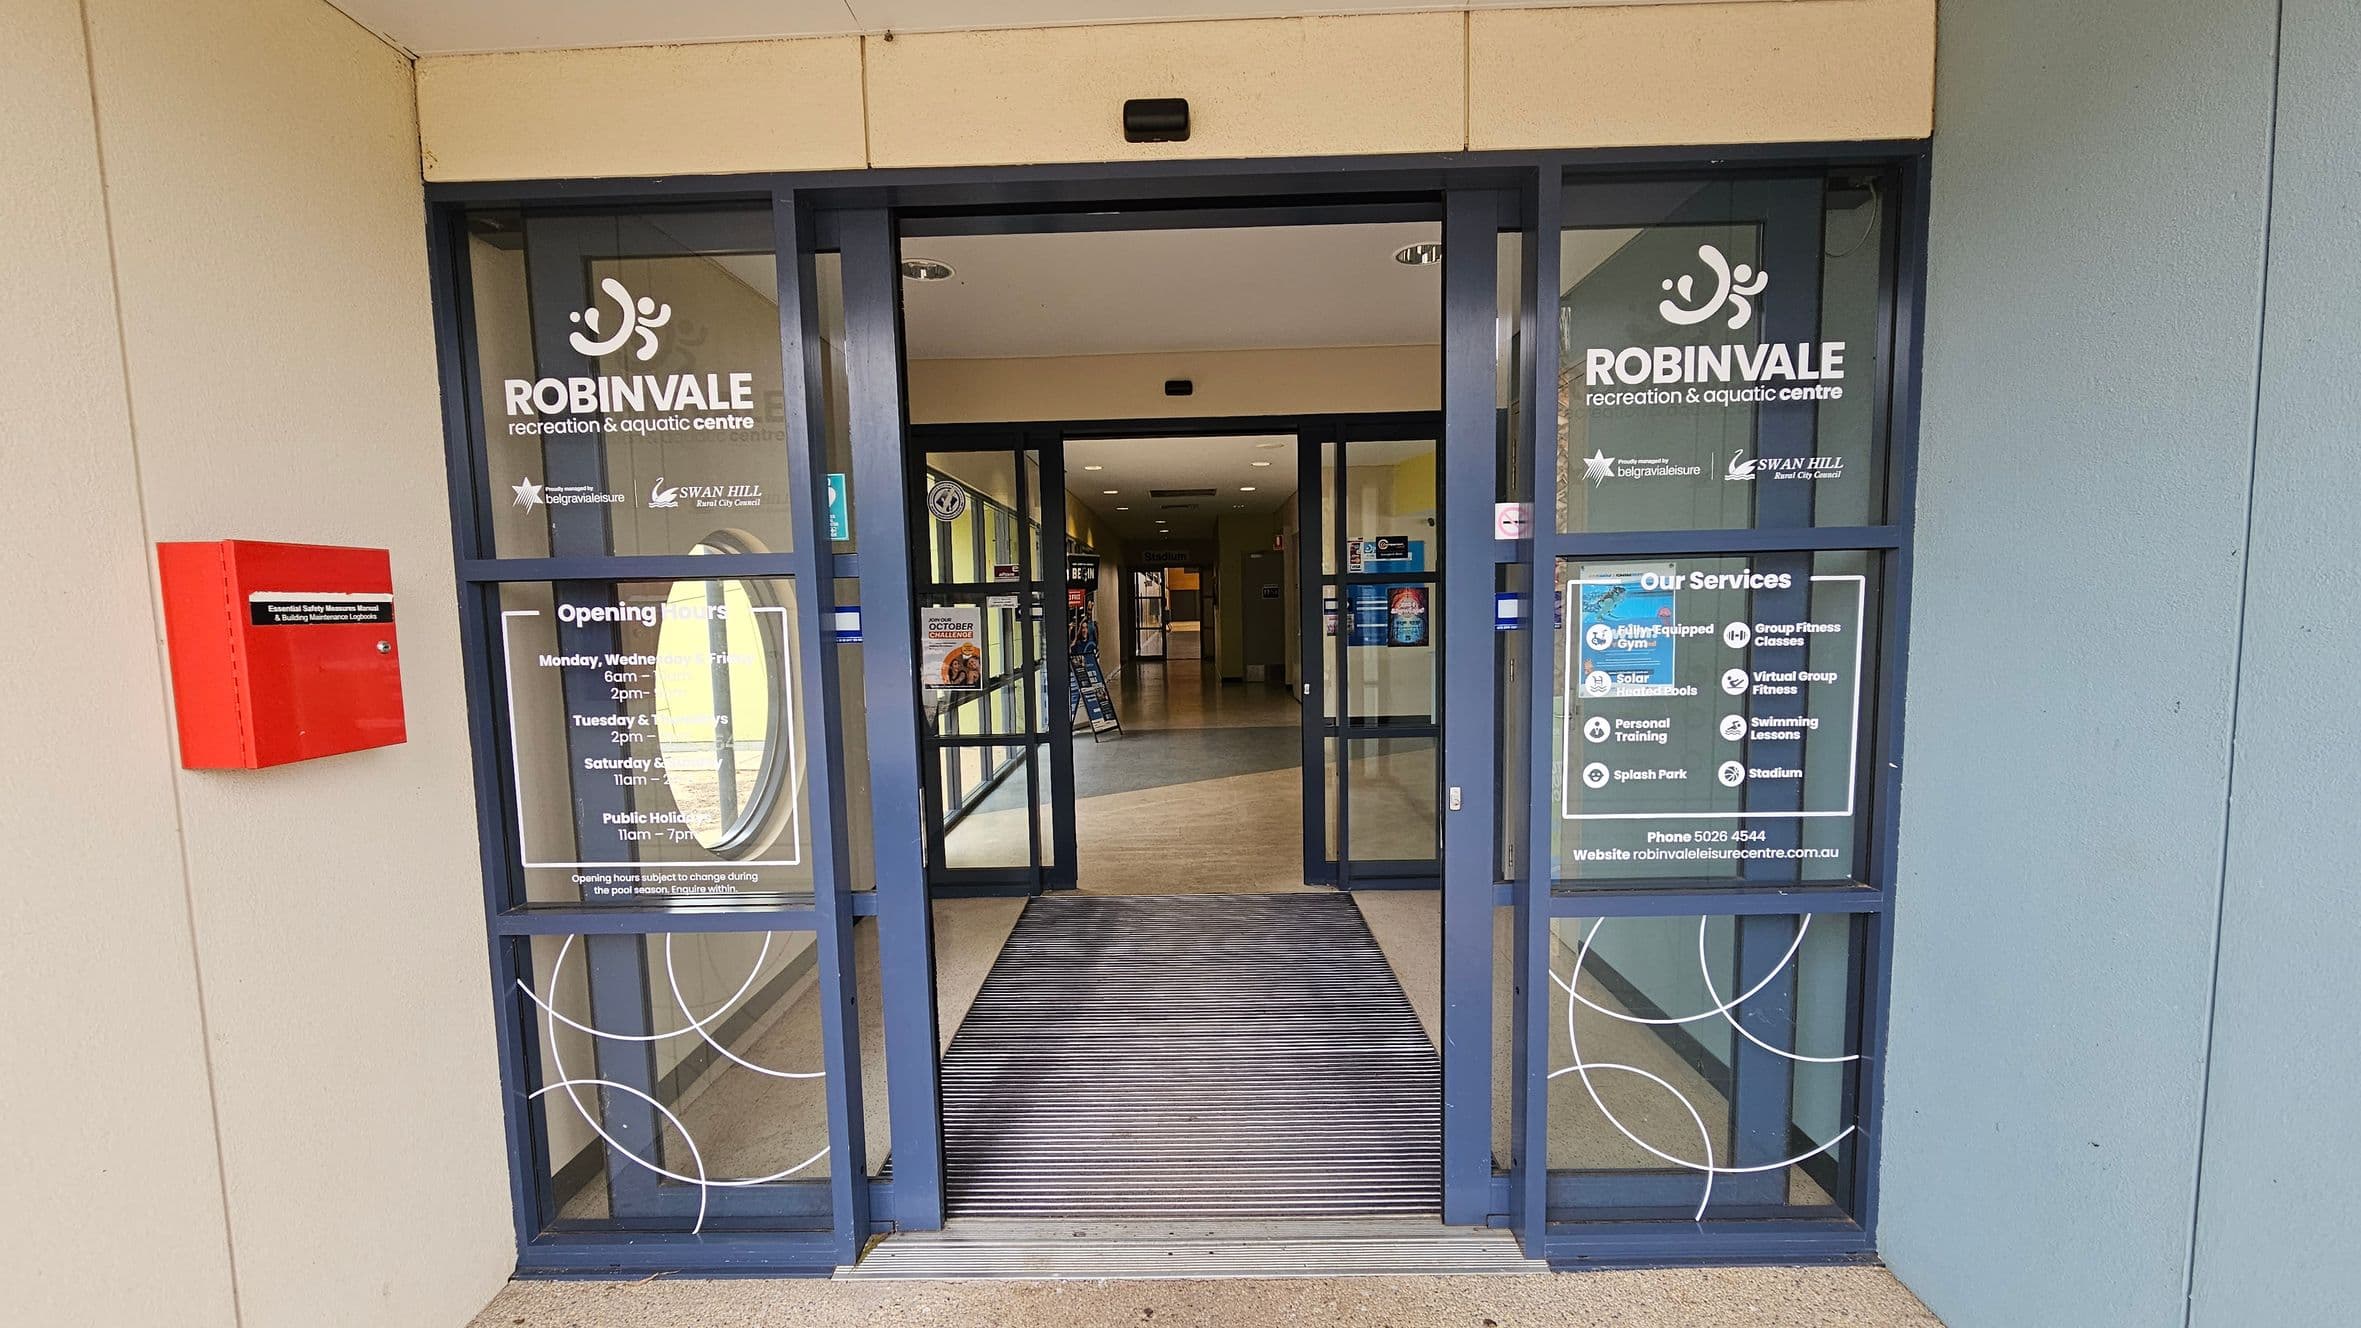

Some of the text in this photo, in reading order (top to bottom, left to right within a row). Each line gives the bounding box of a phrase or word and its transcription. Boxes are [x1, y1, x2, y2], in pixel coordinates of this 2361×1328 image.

[1586, 342, 1845, 386] ROBINVALE
[504, 373, 754, 416] ROBINVALE
[1586, 384, 1843, 407] recreation & aquatic centre
[508, 415, 754, 436] recreation & aquatic centre
[1757, 457, 1844, 471] SWAN HILL
[1618, 465, 1700, 479] belgravialeisure
[1774, 470, 1841, 480] Rural City Council
[679, 485, 762, 498] SWAN HILL
[545, 493, 625, 506] belgravialeisure
[718, 499, 733, 508] City
[734, 499, 761, 507] Council
[1144, 552, 1187, 561] Stadium
[1072, 567, 1094, 579] BEIN
[1640, 568, 1791, 590] Our Services
[302, 605, 324, 613] Safety
[558, 602, 728, 627] Opening Hours
[281, 614, 308, 622] Building
[1755, 622, 1841, 635] Group Fitness
[1617, 639, 1648, 651] Gym
[1755, 636, 1804, 647] Classes
[539, 654, 602, 669] Monday,
[604, 671, 637, 683] 6am
[1617, 673, 1650, 683] Solar
[1753, 671, 1837, 684] Virtual Group
[1664, 685, 1697, 697] Pools
[1752, 685, 1797, 695] Fitness
[573, 714, 635, 729] Tuesday
[637, 714, 649, 726] &
[1615, 719, 1670, 730] Personal
[1751, 717, 1818, 729] Swimming
[611, 731, 643, 746] 2pm
[1615, 732, 1667, 744] Training
[1750, 730, 1800, 740] Lessons
[584, 757, 651, 772] Saturday
[1613, 769, 1687, 782] Splash Park
[1749, 768, 1802, 779] Stadium
[613, 774, 647, 786] 11am
[602, 812, 647, 824] Public
[618, 829, 651, 841] 11am
[1647, 830, 1766, 843] Phone 5026 4544
[1573, 847, 1839, 861] Website robinvaleleisurecentre.com.au
[571, 872, 758, 884] Opening hours subject to change during
[594, 886, 609, 894] the
[611, 886, 632, 895] pool
[671, 885, 706, 895] Enquire
[708, 884, 738, 893] within.
